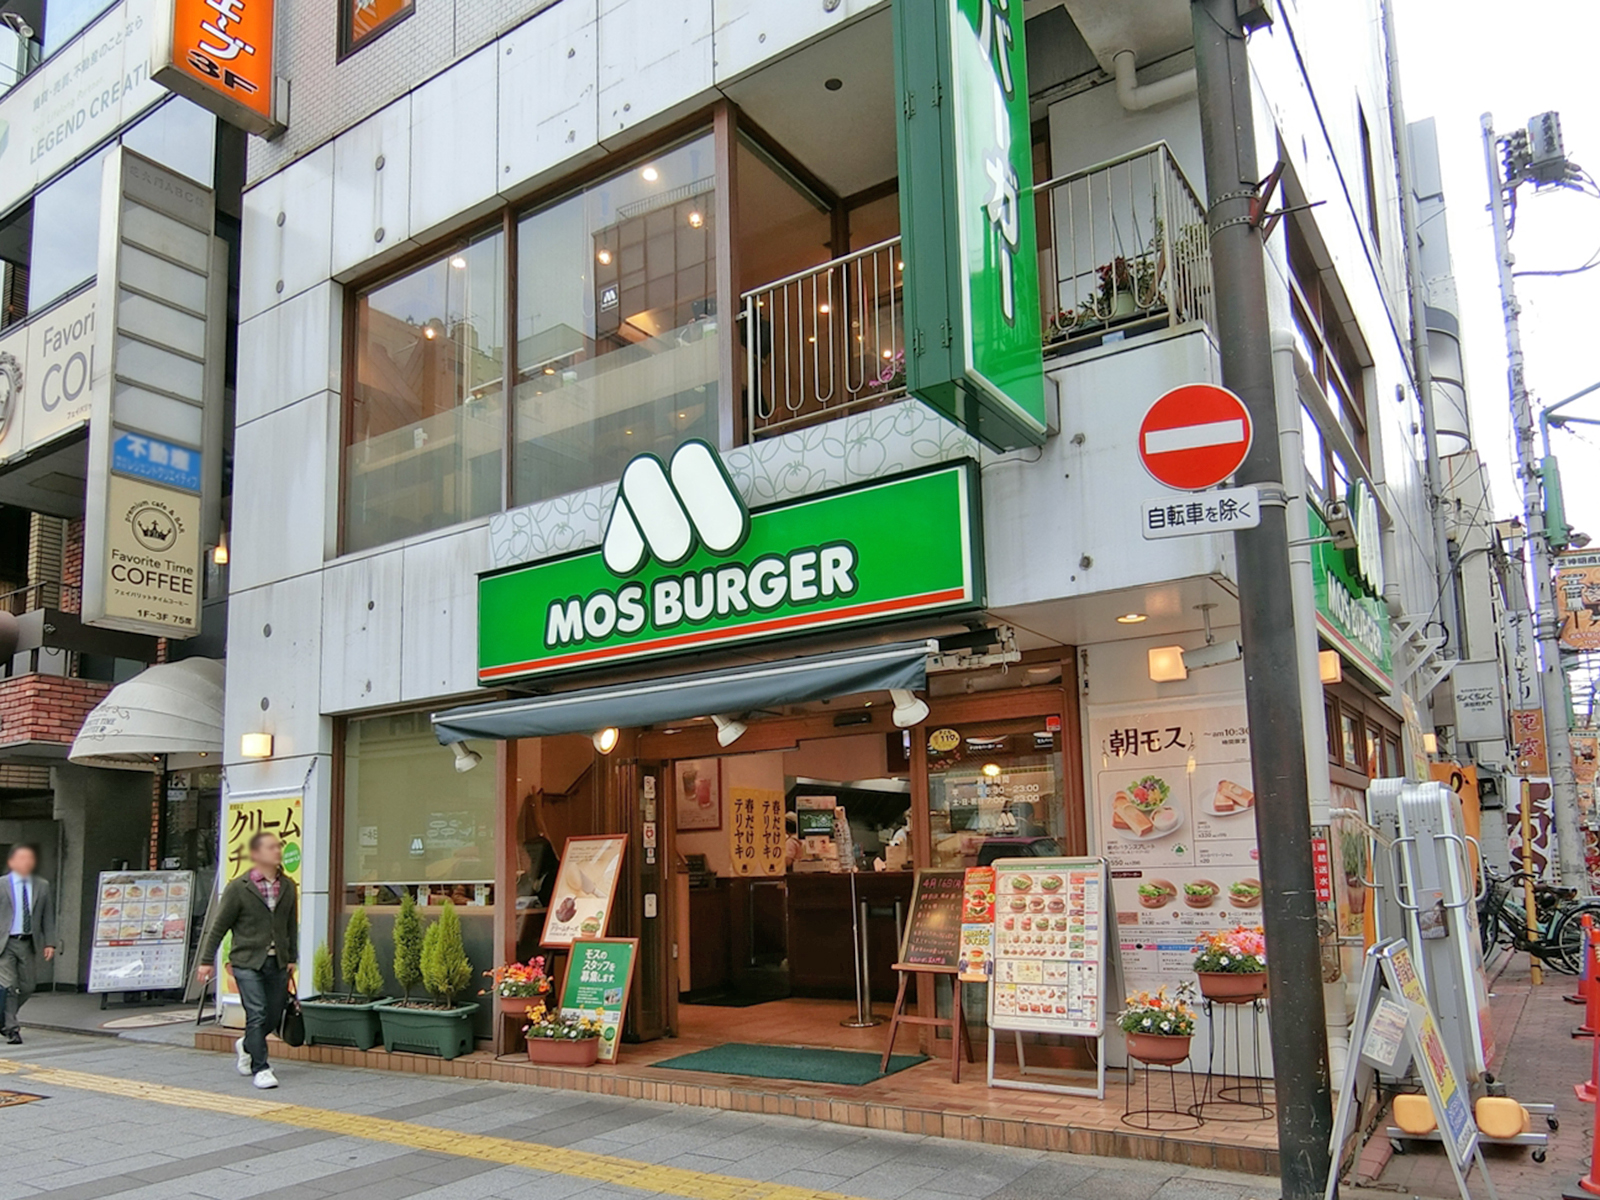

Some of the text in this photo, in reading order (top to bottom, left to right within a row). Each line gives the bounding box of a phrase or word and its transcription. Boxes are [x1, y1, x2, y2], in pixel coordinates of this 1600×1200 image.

[188, 50, 258, 93] 3F
[30, 109, 86, 165] LEGEND
[127, 434, 190, 472] 不動産
[1148, 498, 1252, 529] 自転車を除く
[111, 548, 194, 576] Favorite Time
[111, 564, 194, 595] COFFEE
[547, 545, 855, 645] MOS BURGER
[1109, 727, 1186, 757] 朝モス
[228, 807, 300, 844] クリーム
[734, 798, 744, 859] テリヤキ
[745, 798, 755, 858] 春だけの
[762, 801, 771, 859] テリヤキ
[772, 800, 782, 859] 春だけの
[582, 960, 616, 972] スタッフを
[585, 948, 607, 960] モスの
